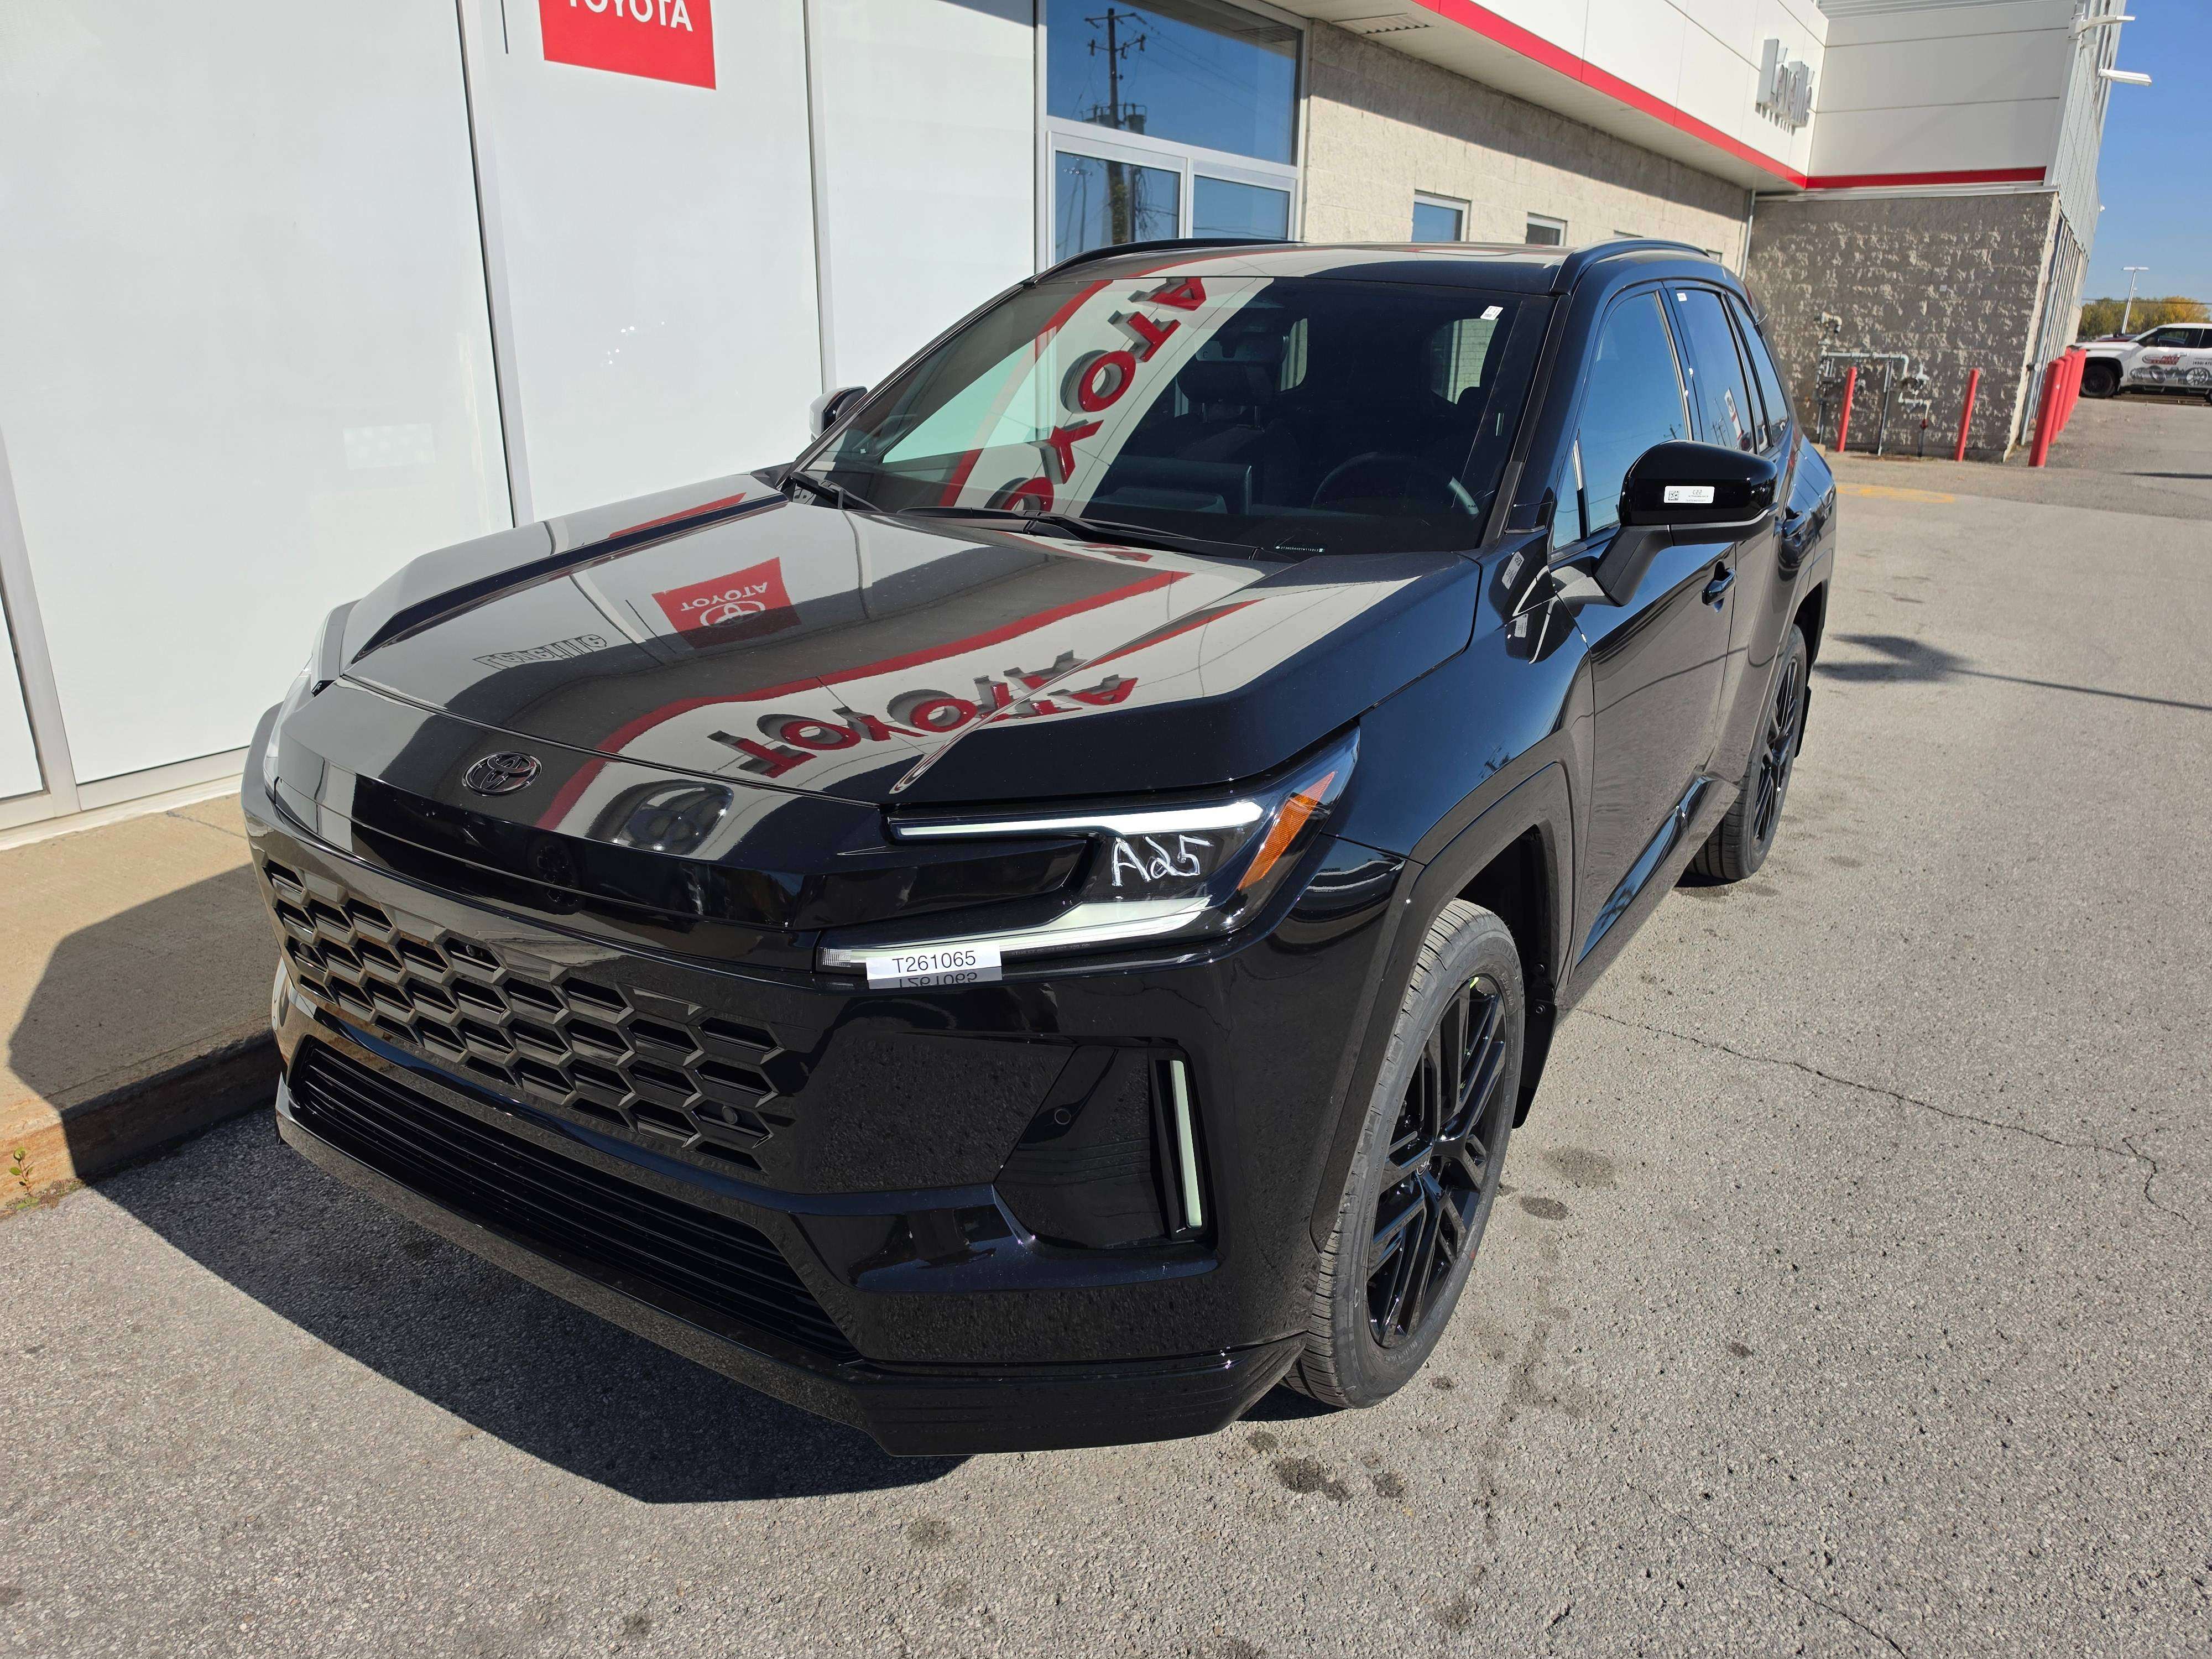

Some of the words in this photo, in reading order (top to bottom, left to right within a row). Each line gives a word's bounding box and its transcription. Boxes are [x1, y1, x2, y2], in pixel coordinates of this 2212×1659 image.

[570, 0, 693, 32] YOTA
[1111, 834, 1214, 887] A25
[891, 950, 976, 973] T261065
